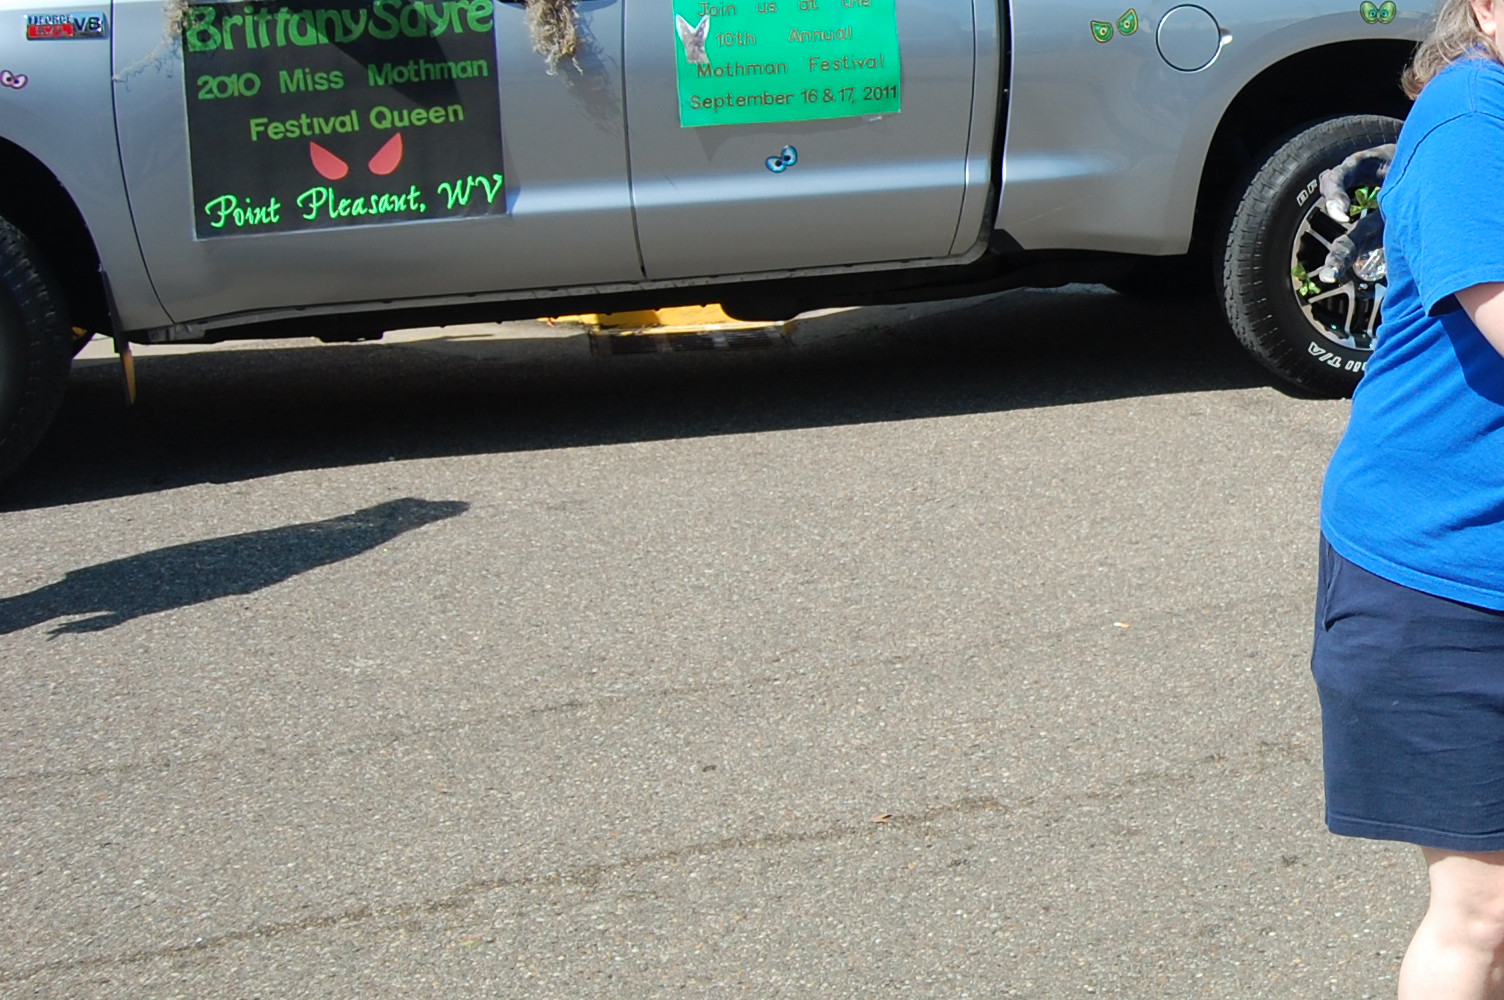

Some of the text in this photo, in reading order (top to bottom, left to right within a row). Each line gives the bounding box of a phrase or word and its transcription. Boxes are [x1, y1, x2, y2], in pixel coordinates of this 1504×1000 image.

[697, 1, 737, 17] Join
[757, 1, 777, 13] us
[716, 26, 852, 47] 10th Annual
[198, 58, 489, 100] 2010 Miss Mothman
[697, 54, 885, 78] Mothman Festival
[689, 90, 794, 112] September
[801, 88, 818, 103] 16
[823, 88, 834, 102] &
[863, 85, 898, 101] 2011
[250, 104, 464, 141] Festival Queen
[205, 173, 503, 228] Point Pleasant, WV
